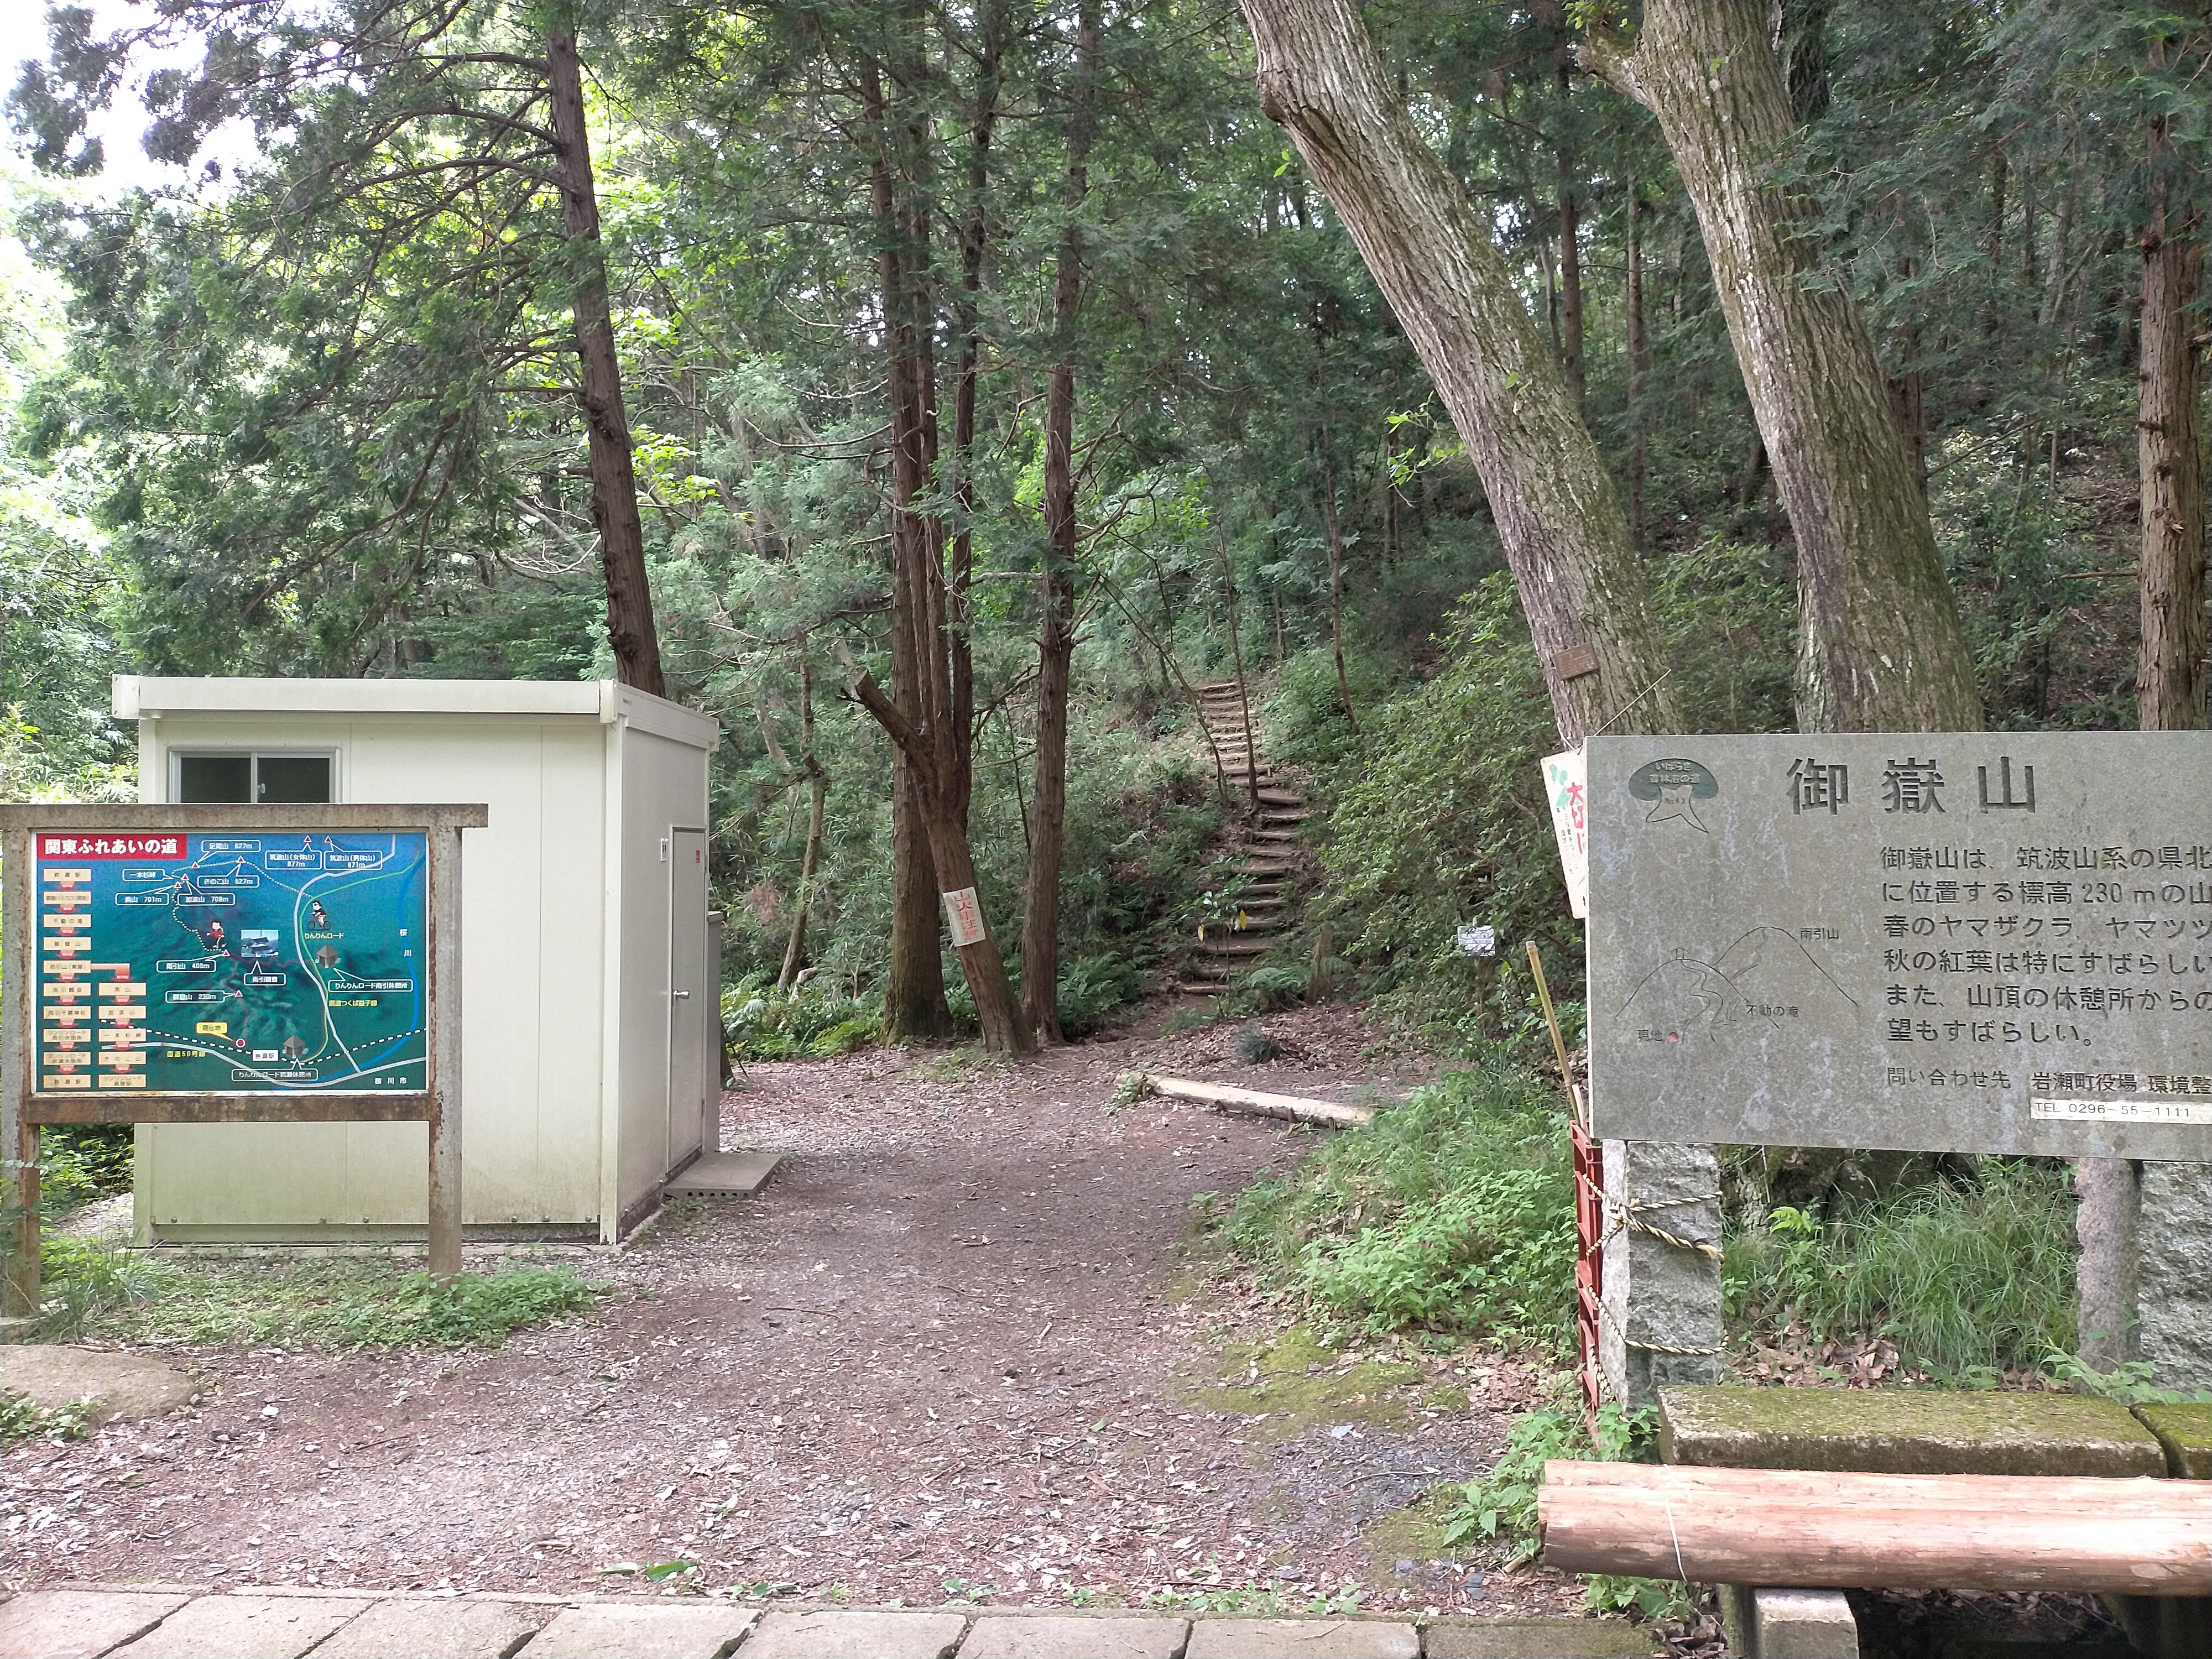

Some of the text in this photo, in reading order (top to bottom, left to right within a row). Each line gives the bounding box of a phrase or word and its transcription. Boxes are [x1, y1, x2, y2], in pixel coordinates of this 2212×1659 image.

[1655, 761, 1691, 771] いばらき
[1648, 774, 1700, 784] 森林浴の道
[1786, 756, 2036, 815] 御嶽山
[45, 838, 178, 854] 関東ふれあいの道
[954, 891, 978, 940] 山火事注意
[1800, 927, 1840, 941] 雨引山
[1745, 1004, 1799, 1018] 不動の滝
[1636, 1029, 1663, 1042] 現地
[1887, 1017, 2091, 1047] 望もすばらしい。
[1887, 1066, 2012, 1090] 問い合わせ先
[2031, 1071, 2138, 1093] 岩瀬町役場
[2034, 1101, 2192, 1118] TEL 0296-55-1111
